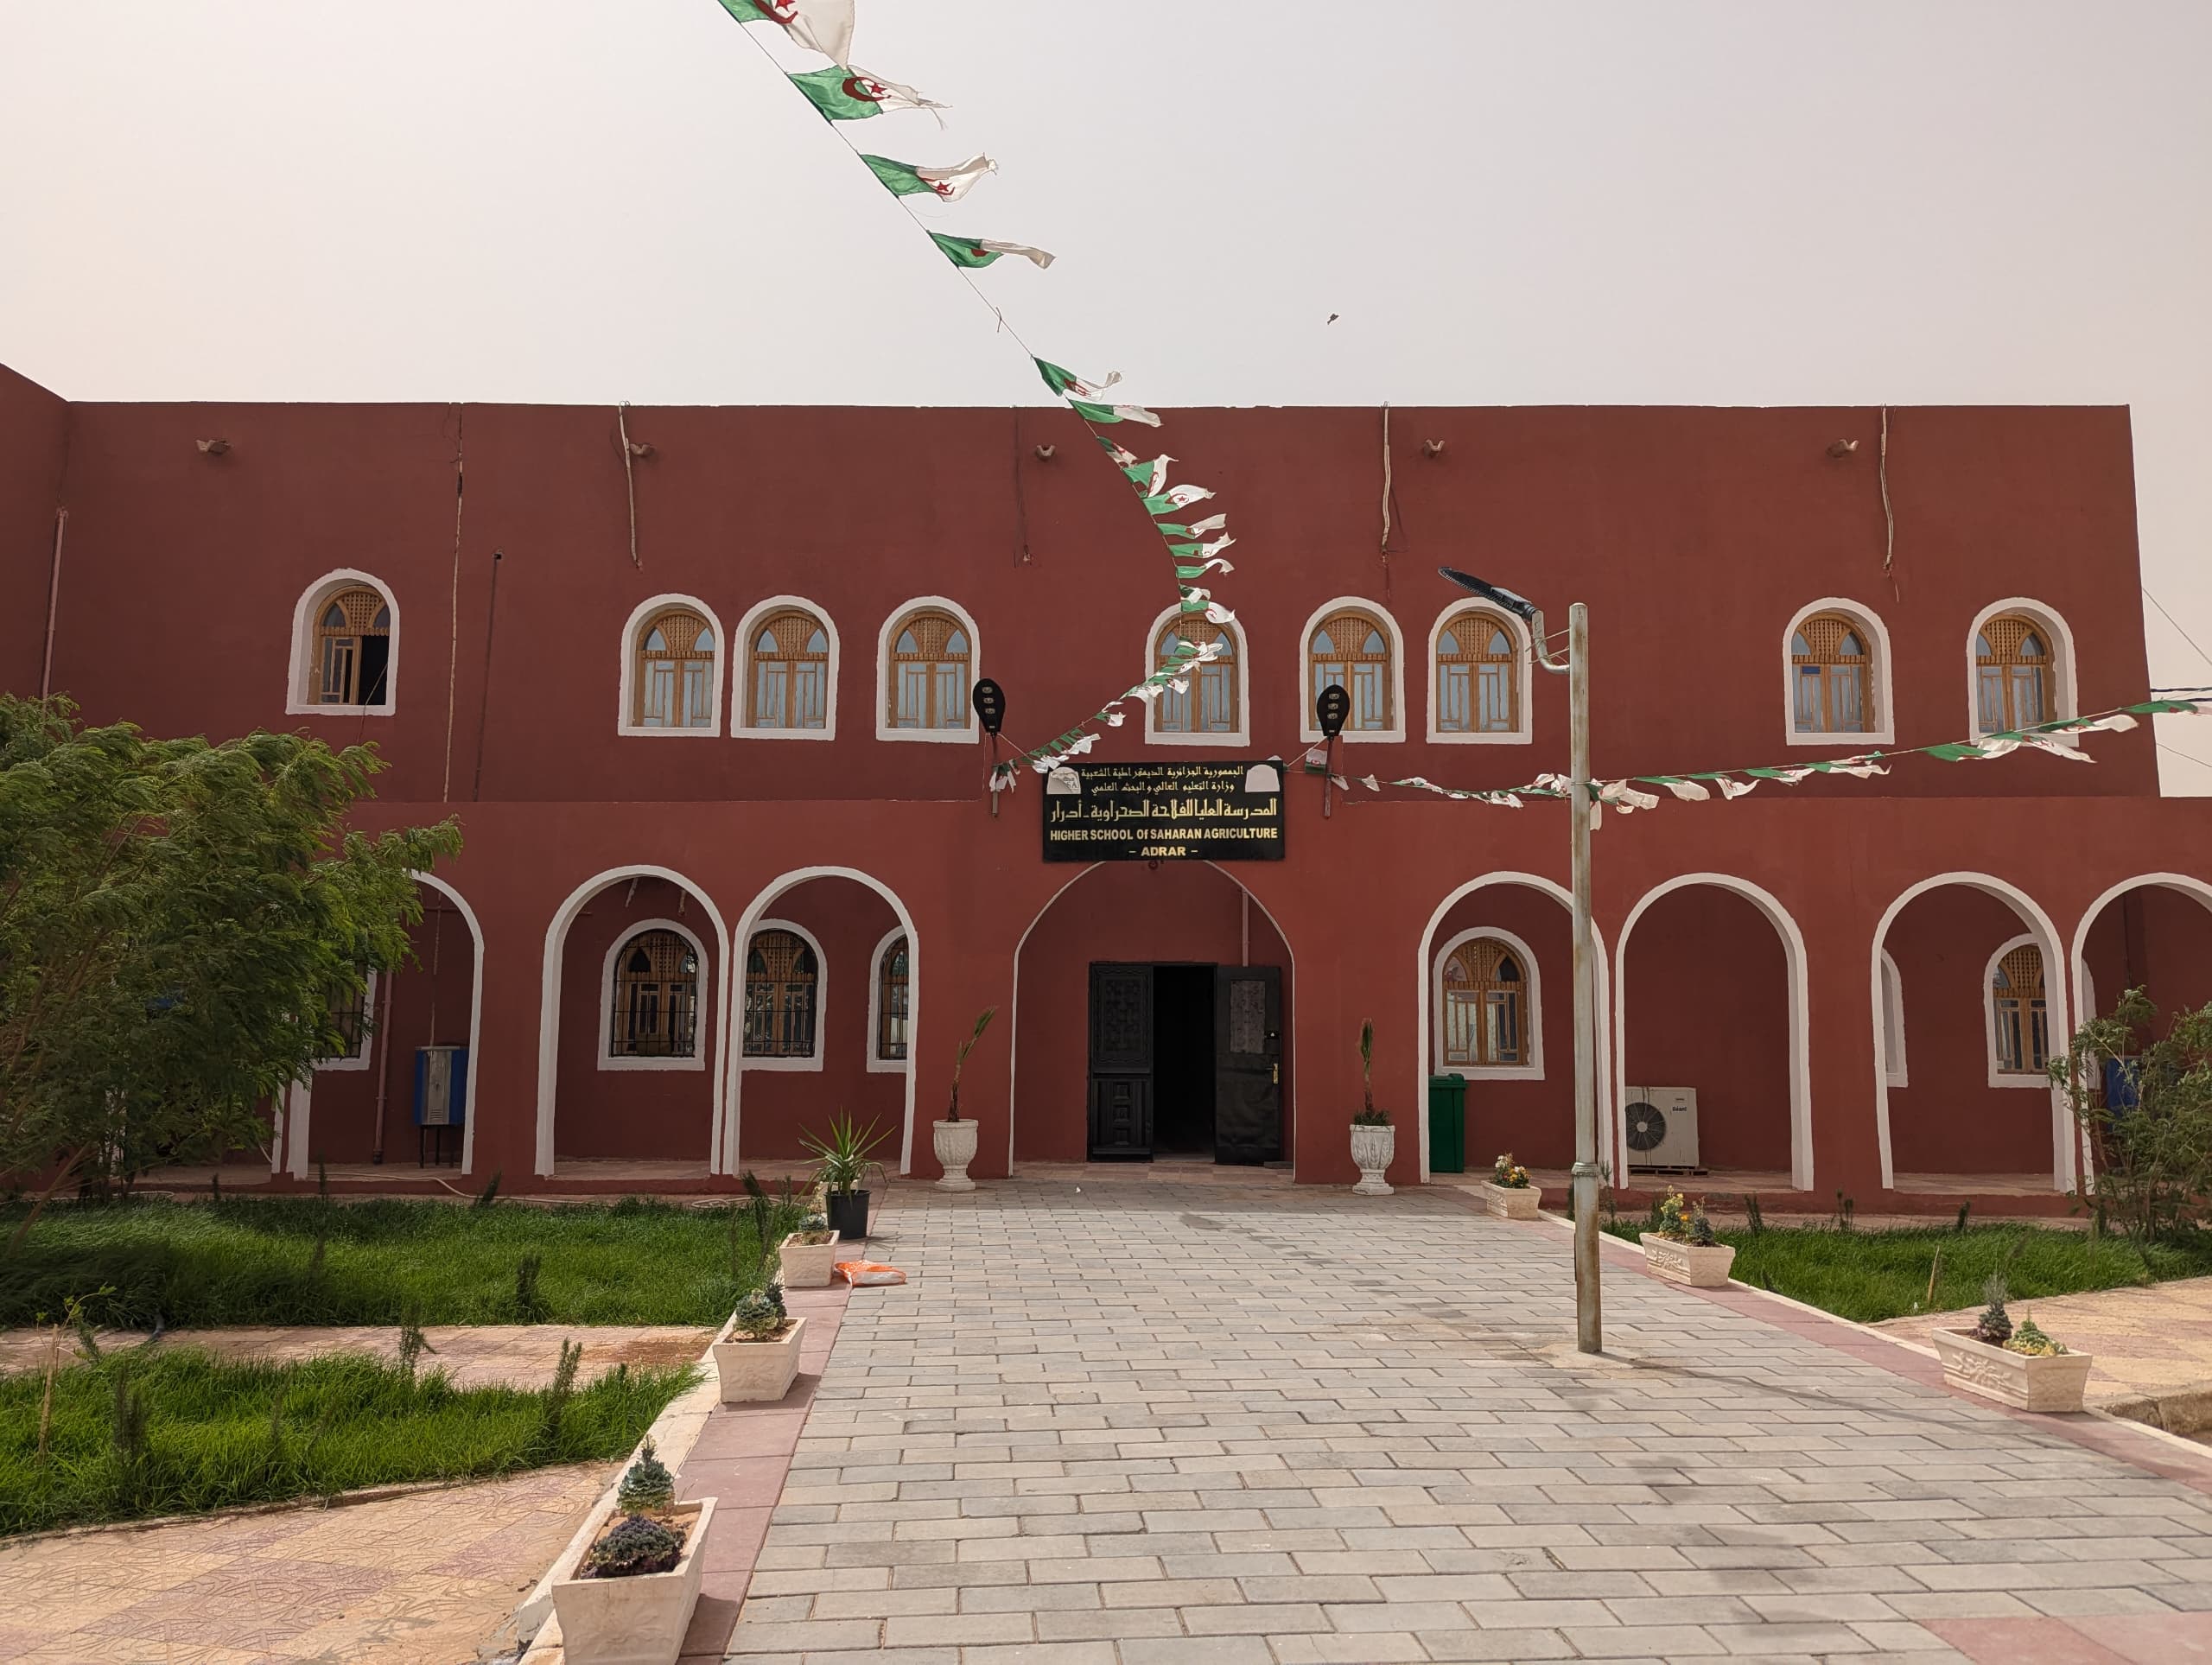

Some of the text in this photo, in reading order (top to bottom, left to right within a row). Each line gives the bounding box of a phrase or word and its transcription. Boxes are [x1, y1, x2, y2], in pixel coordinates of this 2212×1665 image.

[1081, 767, 1110, 780] الشعبية
[1204, 765, 1244, 778] الجمهورية
[1090, 782, 1118, 796] العلمي
[1153, 781, 1179, 795] العالي
[1183, 780, 1209, 793] التعليم
[1211, 780, 1235, 793] وزارة
[1050, 798, 1083, 823] أدرار
[1090, 798, 1150, 822] الصحراوية
[1152, 798, 1193, 820] للفلاحة
[1194, 798, 1223, 820] العليا
[1224, 797, 1278, 820] المدرسة
[1050, 829, 1089, 841] HIGHER
[1090, 829, 1134, 841] SCHOOL
[1150, 829, 1202, 840] SAHARAN
[1203, 828, 1278, 839] AGRICULTURE
[1141, 846, 1186, 856] ADRAR
